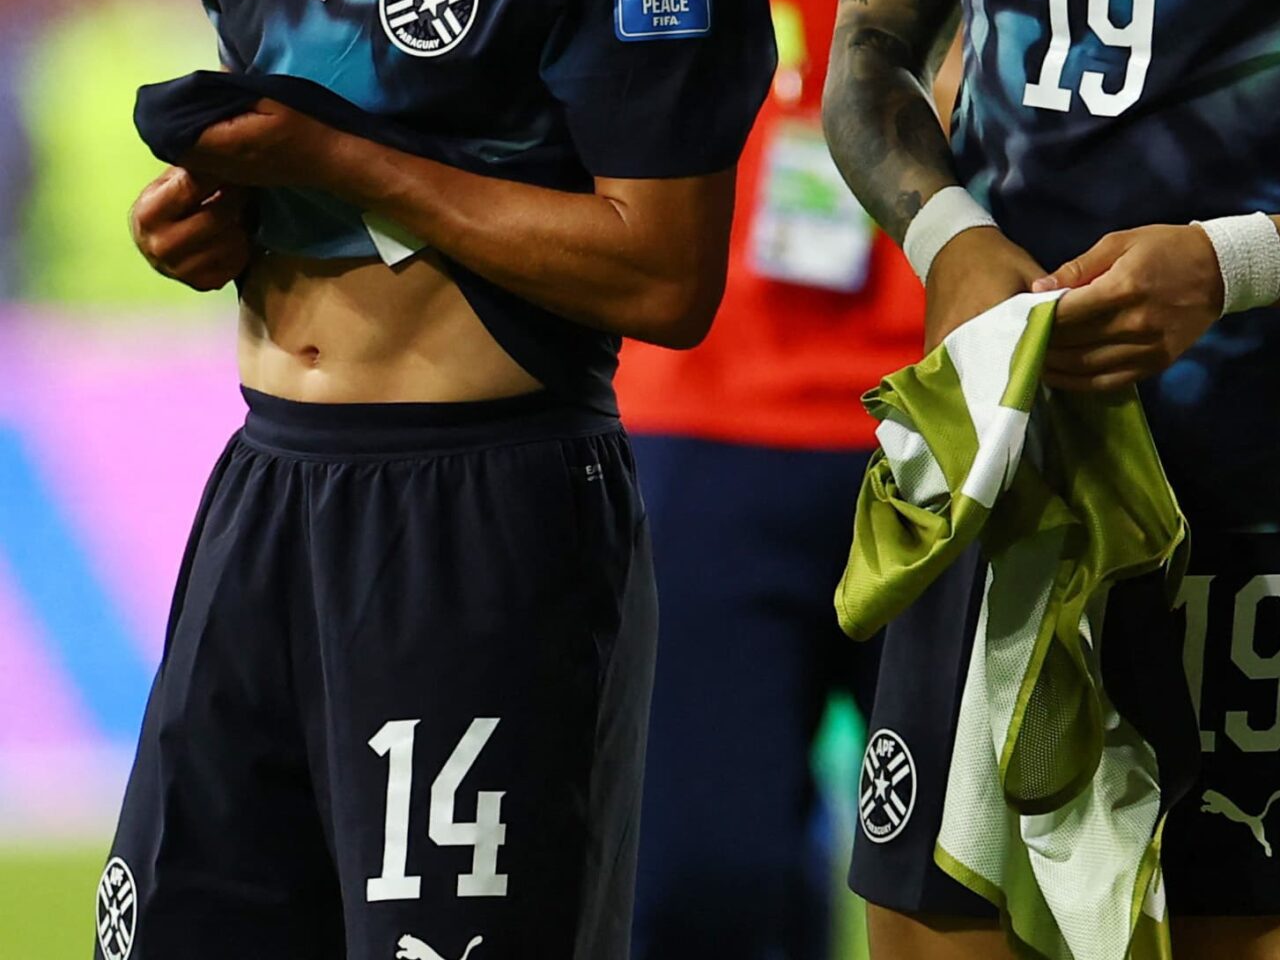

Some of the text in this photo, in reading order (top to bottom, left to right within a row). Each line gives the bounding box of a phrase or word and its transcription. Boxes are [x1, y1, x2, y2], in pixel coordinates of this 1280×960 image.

[652, 15, 681, 28] FIFA
[395, 27, 441, 50] PARAGUAY
[876, 737, 896, 758] APF
[366, 717, 508, 902] 14
